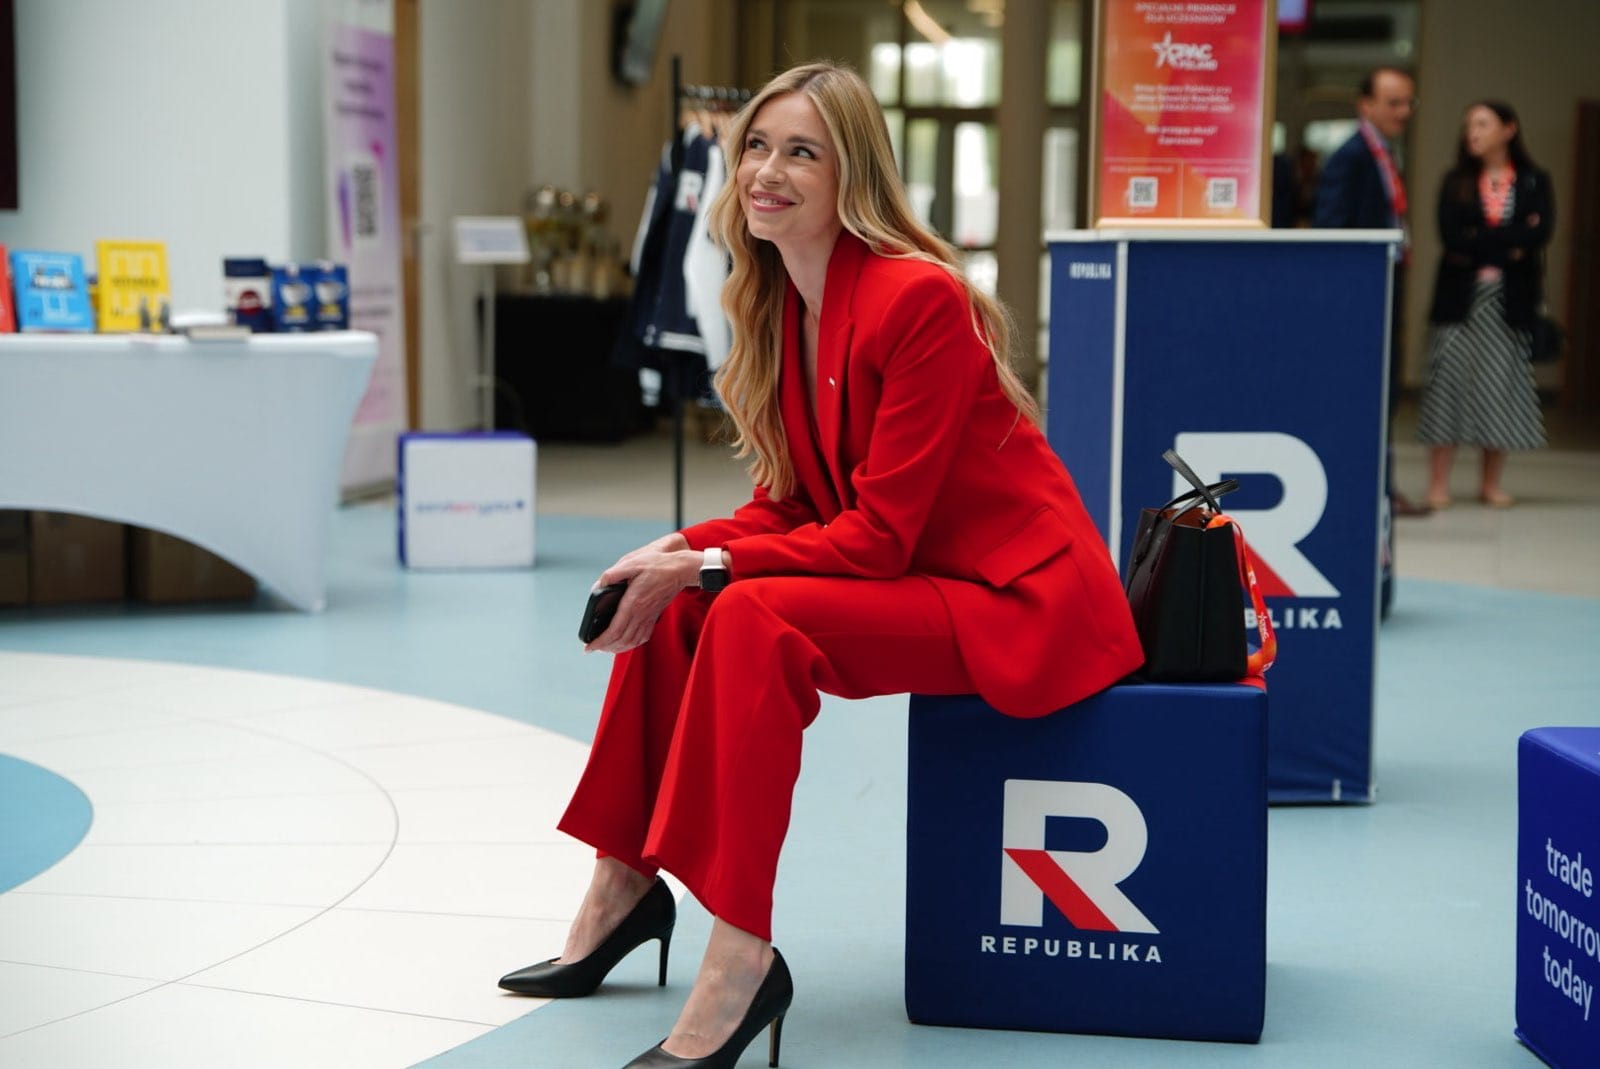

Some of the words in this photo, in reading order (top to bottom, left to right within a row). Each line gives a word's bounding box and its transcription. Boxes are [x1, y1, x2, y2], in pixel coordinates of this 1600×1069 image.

[1174, 432, 1340, 597] R
[1244, 607, 1343, 629] BLIKA
[1001, 779, 1160, 934] R
[1546, 838, 1593, 898] trade
[981, 936, 1162, 963] REPUBLIKA
[1543, 945, 1594, 1021] today
